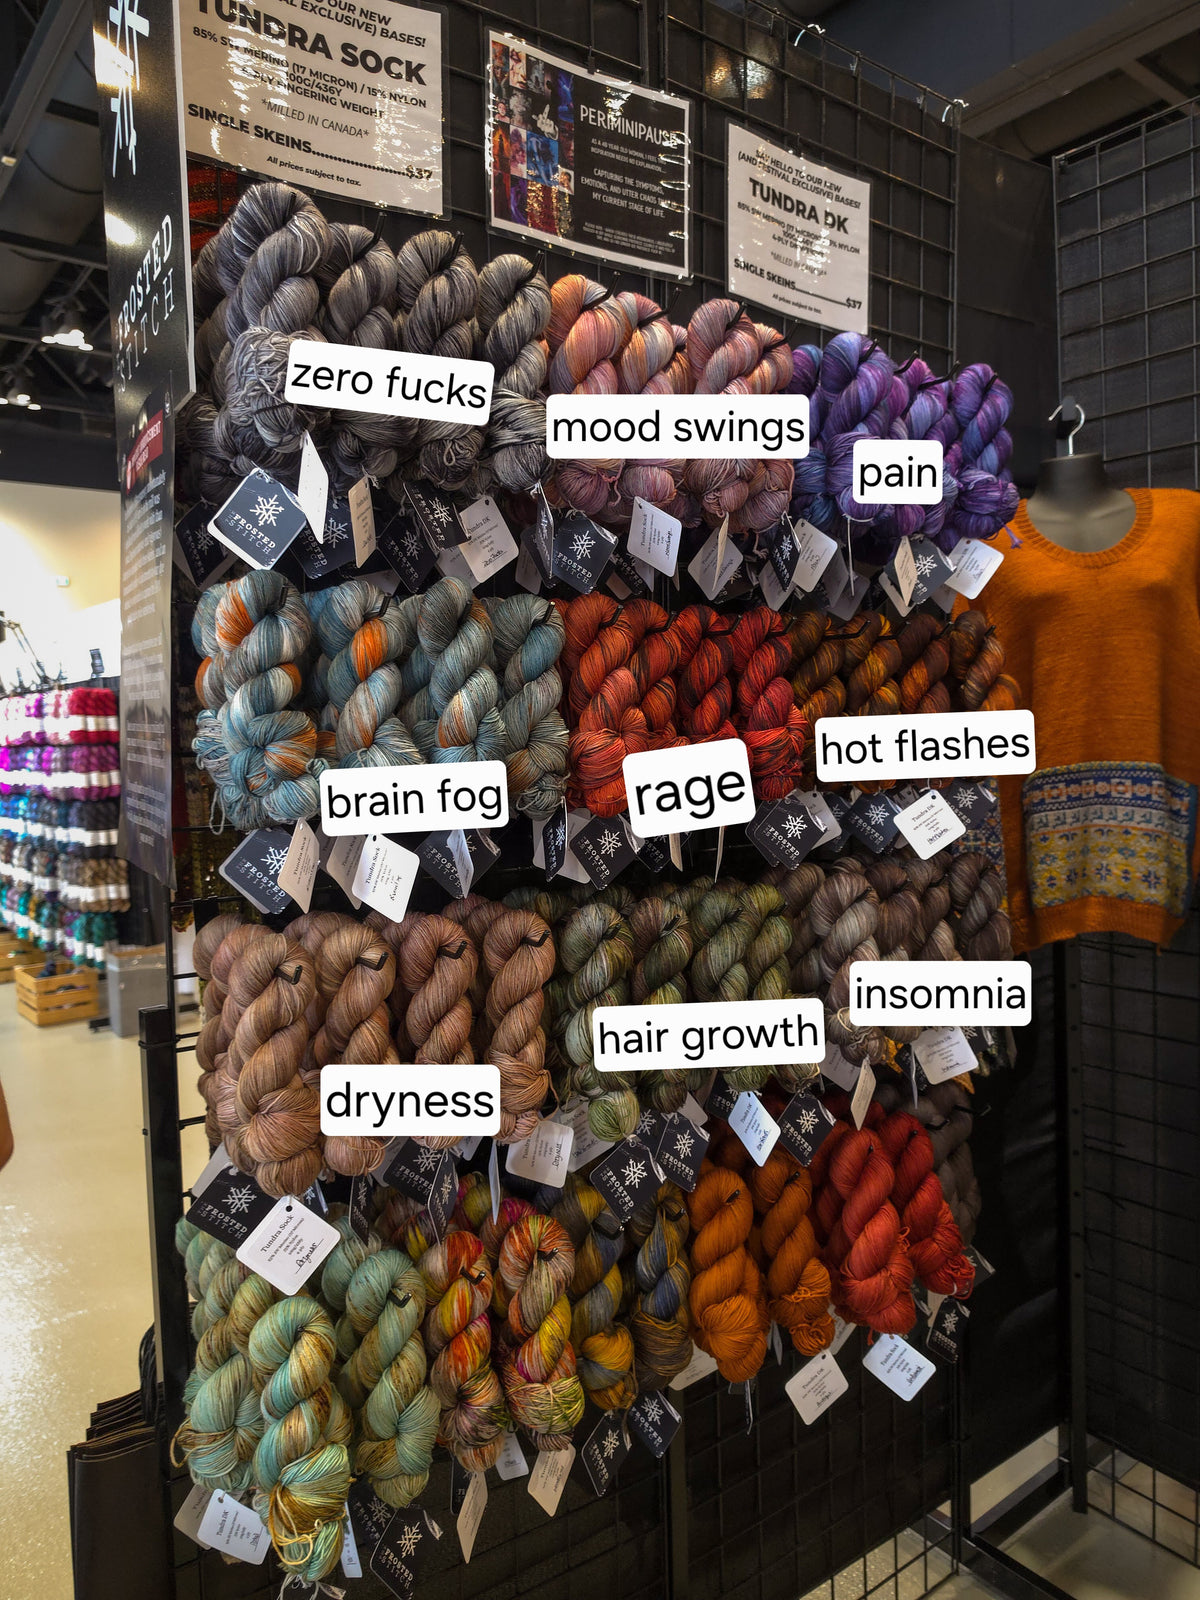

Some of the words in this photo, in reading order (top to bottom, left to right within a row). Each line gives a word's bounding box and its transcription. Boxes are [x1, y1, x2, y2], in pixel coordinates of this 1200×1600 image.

[300, 3, 377, 37] EXCLUSIVE)
[380, 29, 427, 48] BASES!
[332, 0, 356, 15] OUR
[358, 8, 391, 26] NEW
[192, 26, 218, 43] 85%
[243, 47, 289, 68] MERINO
[292, 62, 307, 76] (17
[309, 68, 358, 94] MICRON)
[366, 86, 388, 99] 15%
[389, 92, 428, 108] NYLON
[341, 42, 427, 86] SOCK
[187, 103, 250, 134] SINGLE
[307, 114, 319, 127] IN
[340, 98, 385, 118] WEIGHT
[267, 155, 278, 167] All
[279, 160, 303, 174] prices
[305, 167, 336, 183] subject
[346, 177, 362, 187] tax.
[594, 168, 623, 183] CAPTURING
[624, 177, 634, 187] THE
[738, 151, 758, 165] (AND
[792, 177, 833, 201] EXCLUSIVE)
[835, 194, 861, 209] BASES!
[771, 157, 793, 174] HELLO
[806, 174, 822, 186] OUR
[593, 192, 601, 201] MY
[602, 195, 627, 208] CURRENT
[609, 185, 621, 195] AND
[622, 188, 638, 199] UTTER
[749, 177, 820, 225] TUNDRA
[825, 209, 849, 234] DK
[117, 214, 173, 350] FROSTED
[734, 259, 764, 279] SINGLE
[846, 297, 862, 310] $37
[118, 268, 174, 393] STITCH
[228, 518, 271, 555] STITCH
[233, 513, 276, 549] FROSTED
[557, 552, 593, 579] FROSTED
[769, 827, 800, 856] FROSTED
[854, 815, 885, 841] FROSTED
[431, 848, 460, 878] FROST
[584, 839, 610, 876] FROSTED
[239, 865, 282, 902] STITCH
[244, 861, 286, 897] FROSTED
[786, 1122, 813, 1152] FROSTED
[400, 1165, 433, 1190] FROSTED
[665, 1152, 694, 1175] FROSTED
[607, 1170, 634, 1208] FROSTED
[200, 1210, 243, 1240] STITCH
[205, 1204, 247, 1233] FROSTED
[260, 1229, 283, 1252] Tundra
[279, 1214, 294, 1231] Sock
[631, 1406, 662, 1443] FROSTED
[385, 1548, 414, 1582] FROSTED
